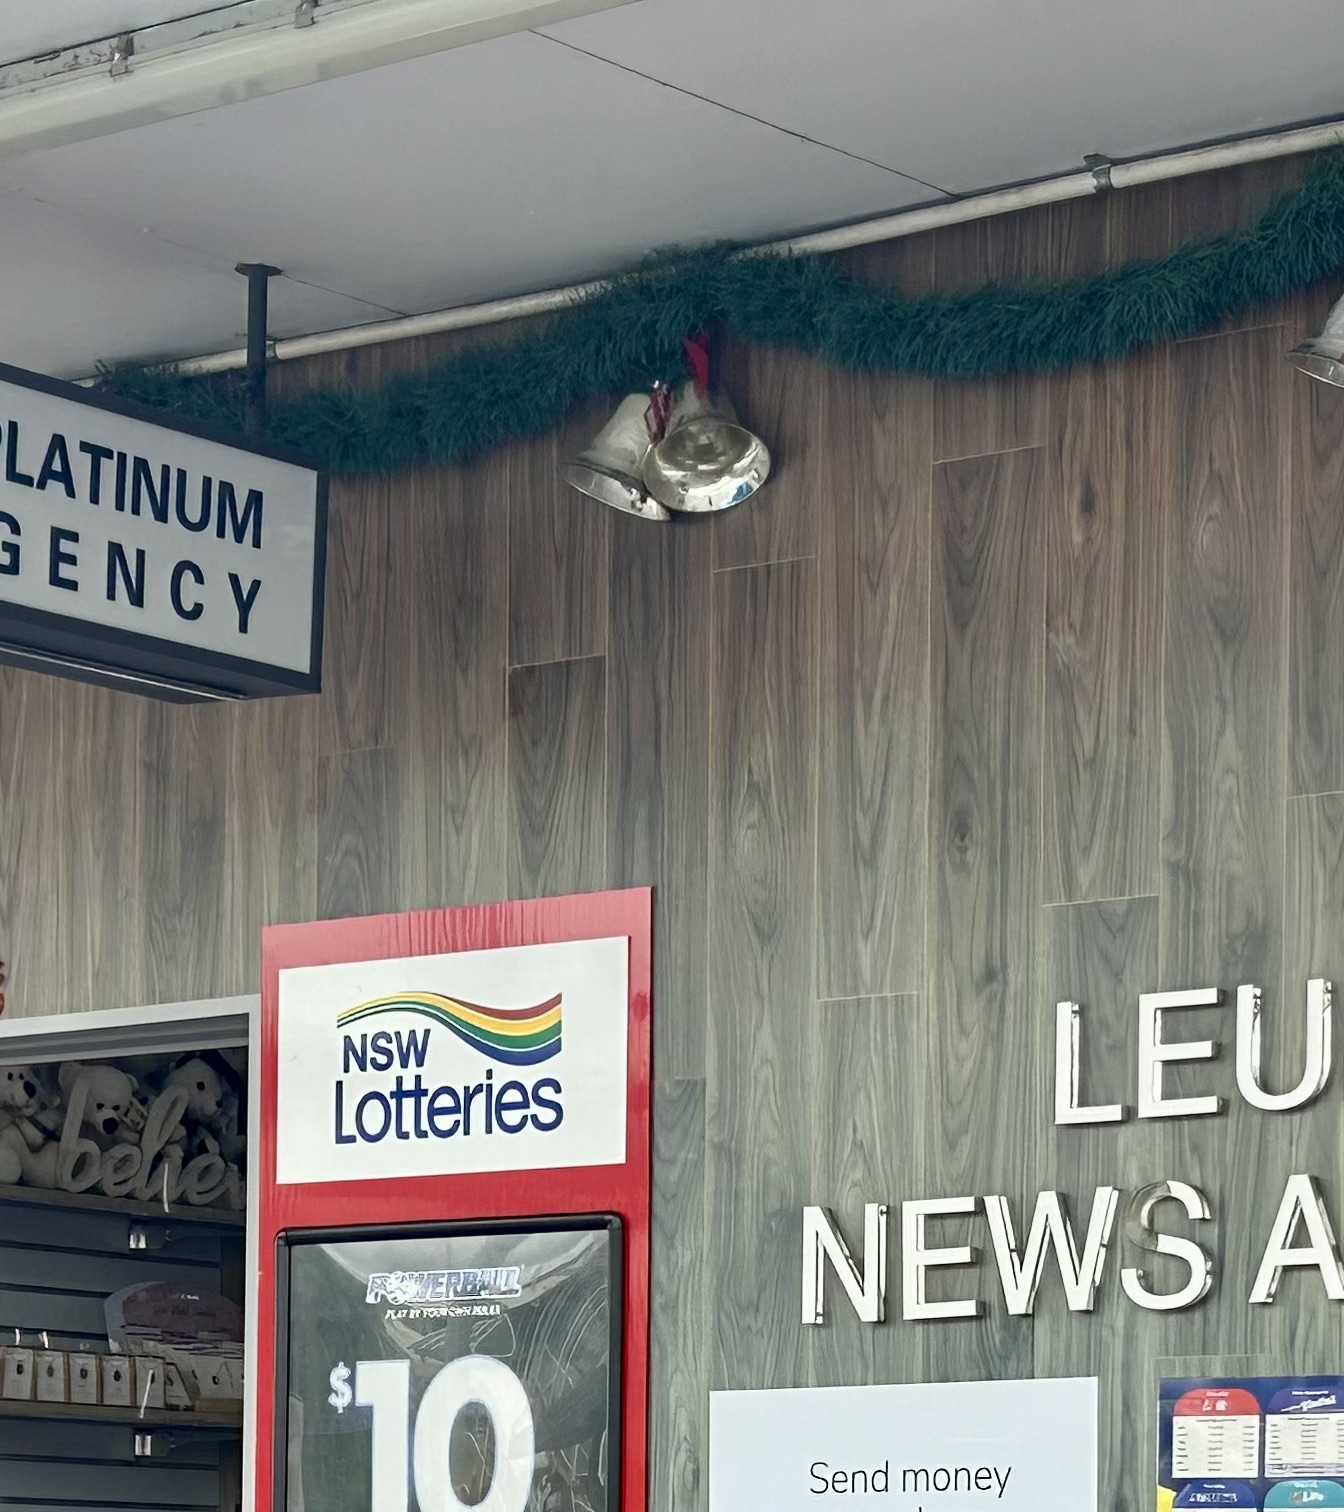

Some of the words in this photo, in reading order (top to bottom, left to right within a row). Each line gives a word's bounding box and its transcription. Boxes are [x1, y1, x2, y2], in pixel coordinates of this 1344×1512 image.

[342, 1028, 431, 1074] NSW
[334, 1067, 565, 1145] Lotteries
[798, 1181, 1214, 1326] NEWS
[808, 1459, 890, 1495] Send
[901, 1465, 1013, 1499] money
